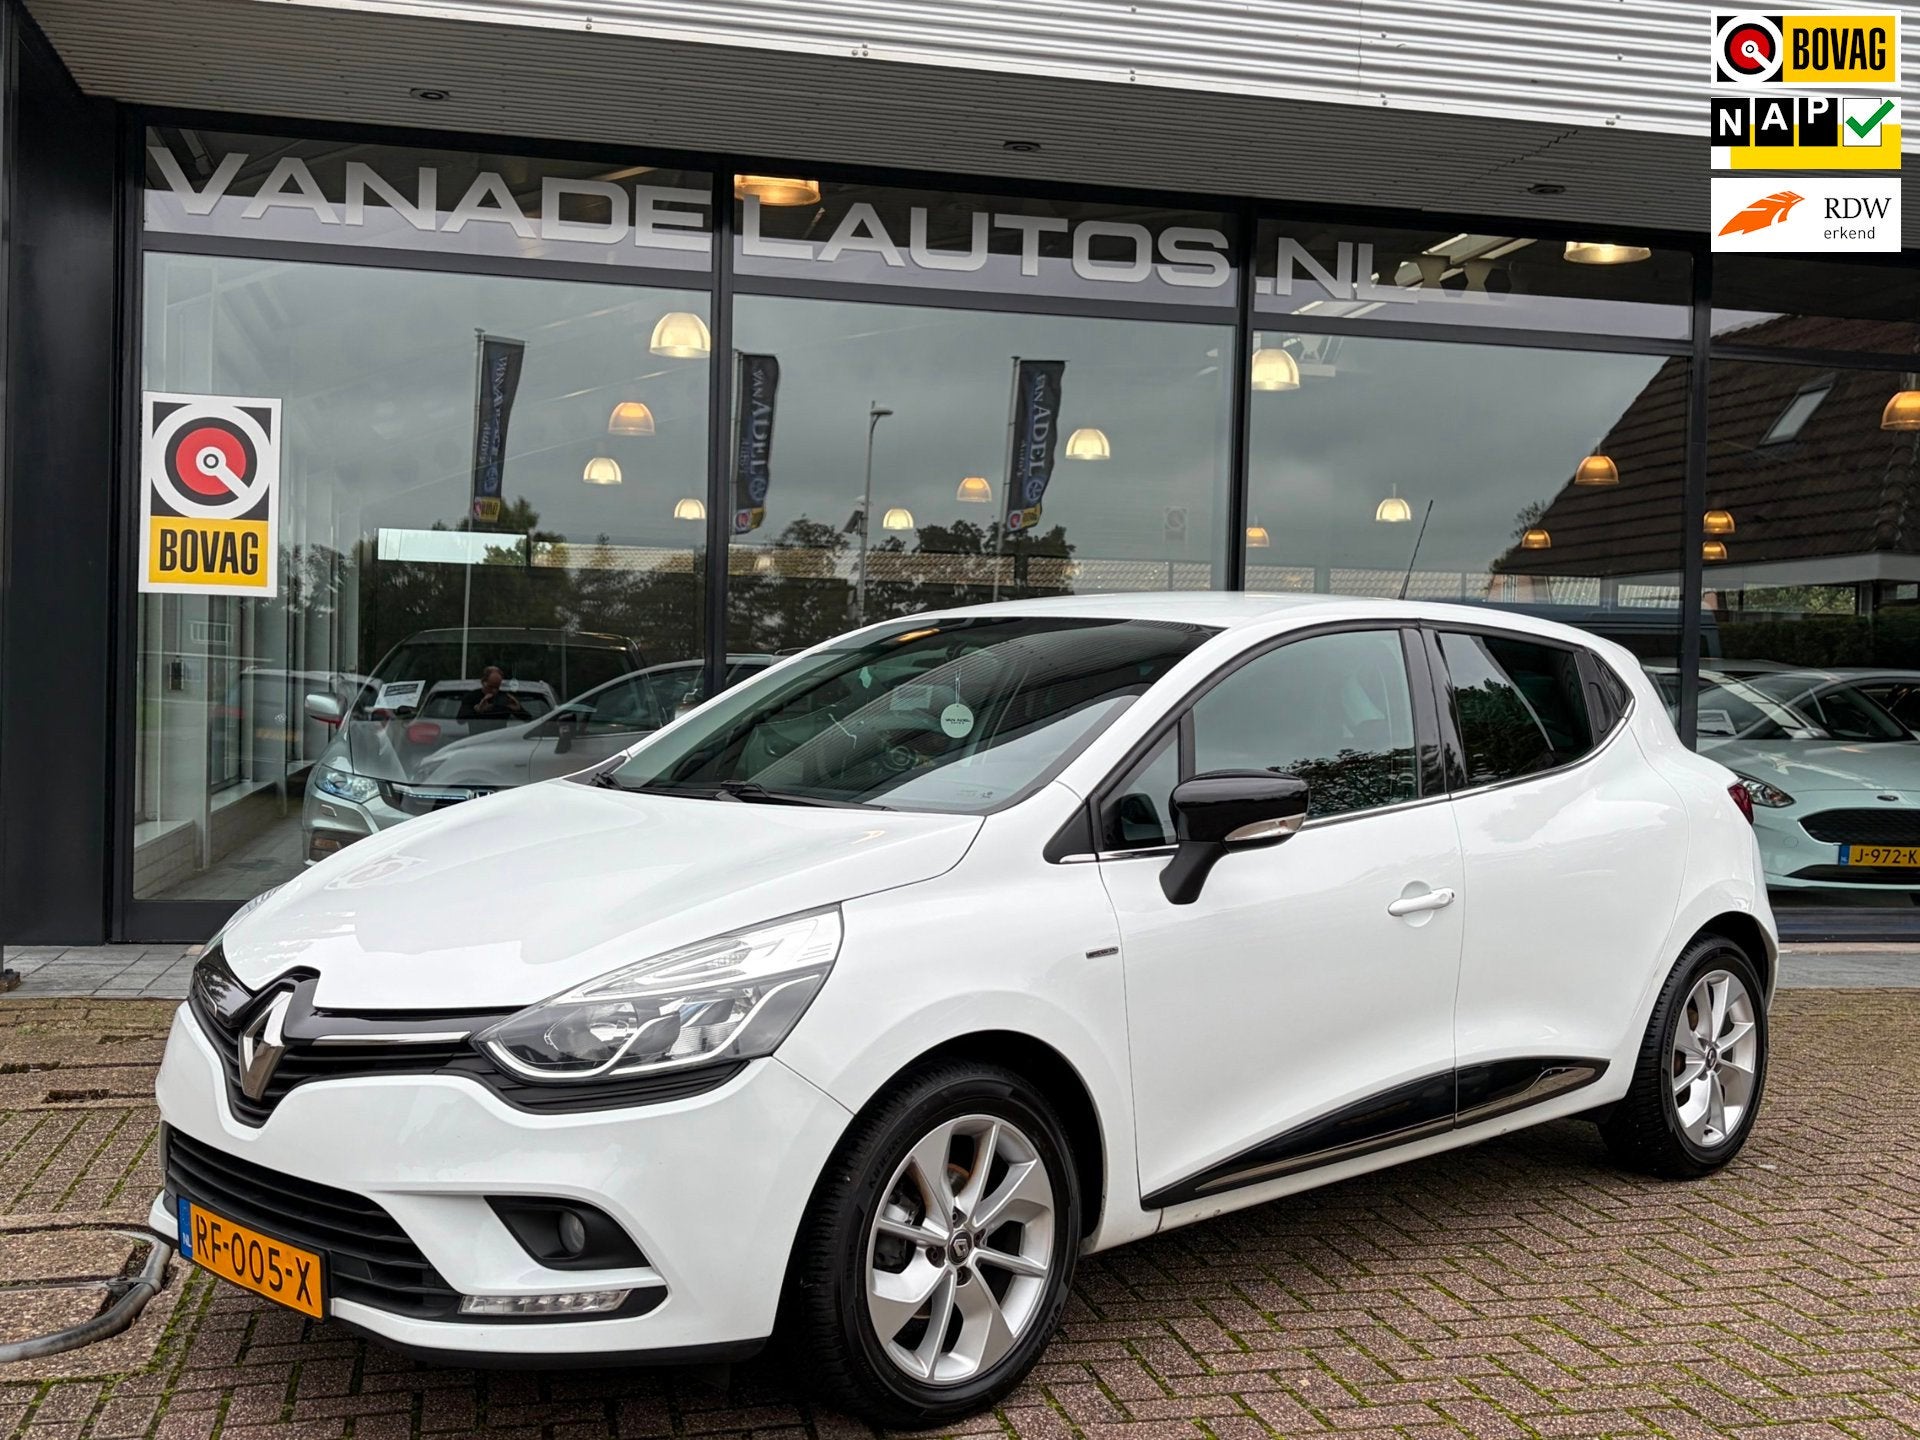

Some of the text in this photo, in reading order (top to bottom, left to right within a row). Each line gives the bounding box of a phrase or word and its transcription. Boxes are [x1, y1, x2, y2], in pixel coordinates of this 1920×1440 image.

[1028, 405, 1051, 477] ADEL
[159, 528, 259, 575] BOVAG
[1855, 848, 1918, 864] J-972-K
[195, 1213, 313, 1307] RF-005-X
